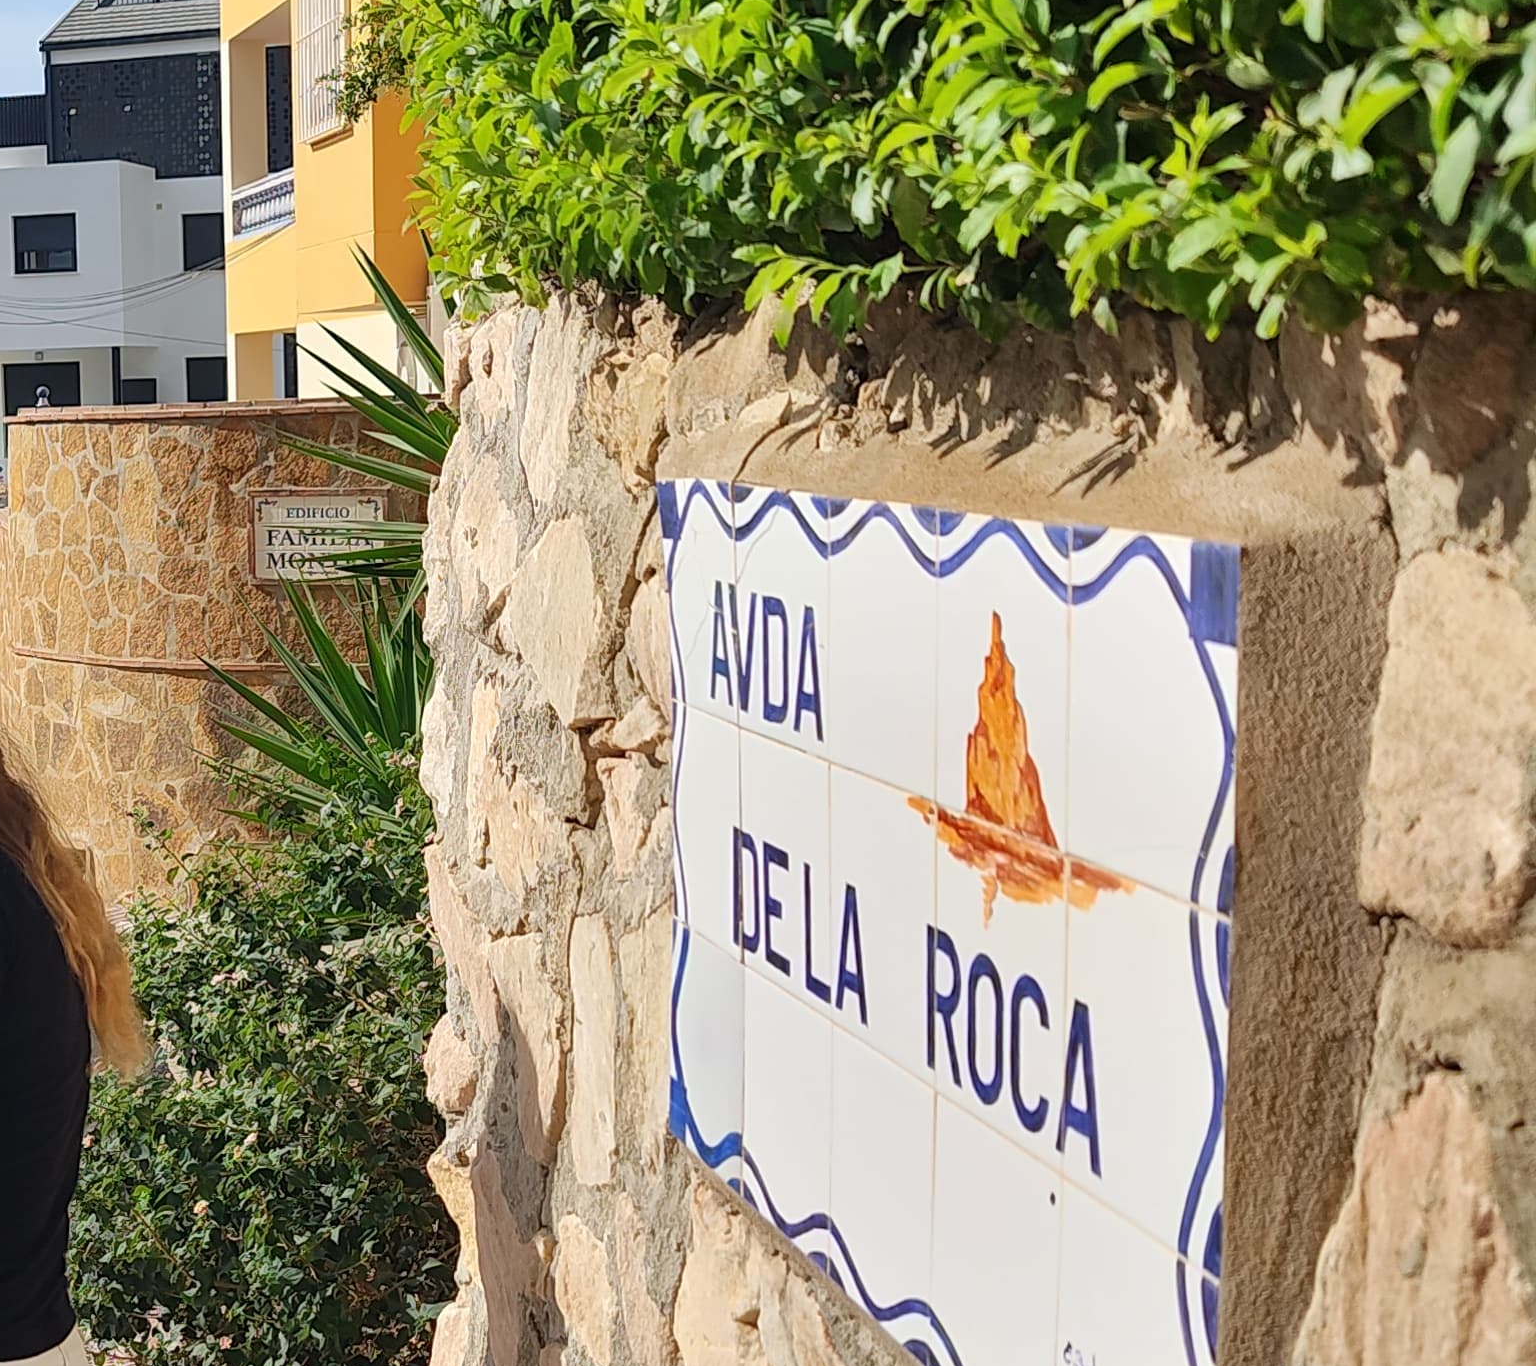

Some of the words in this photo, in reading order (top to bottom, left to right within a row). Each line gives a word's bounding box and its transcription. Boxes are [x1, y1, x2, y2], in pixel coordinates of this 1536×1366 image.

[286, 507, 350, 519] EDIFICIO
[710, 579, 824, 743] AVDA
[925, 924, 1101, 1179] ROCA
